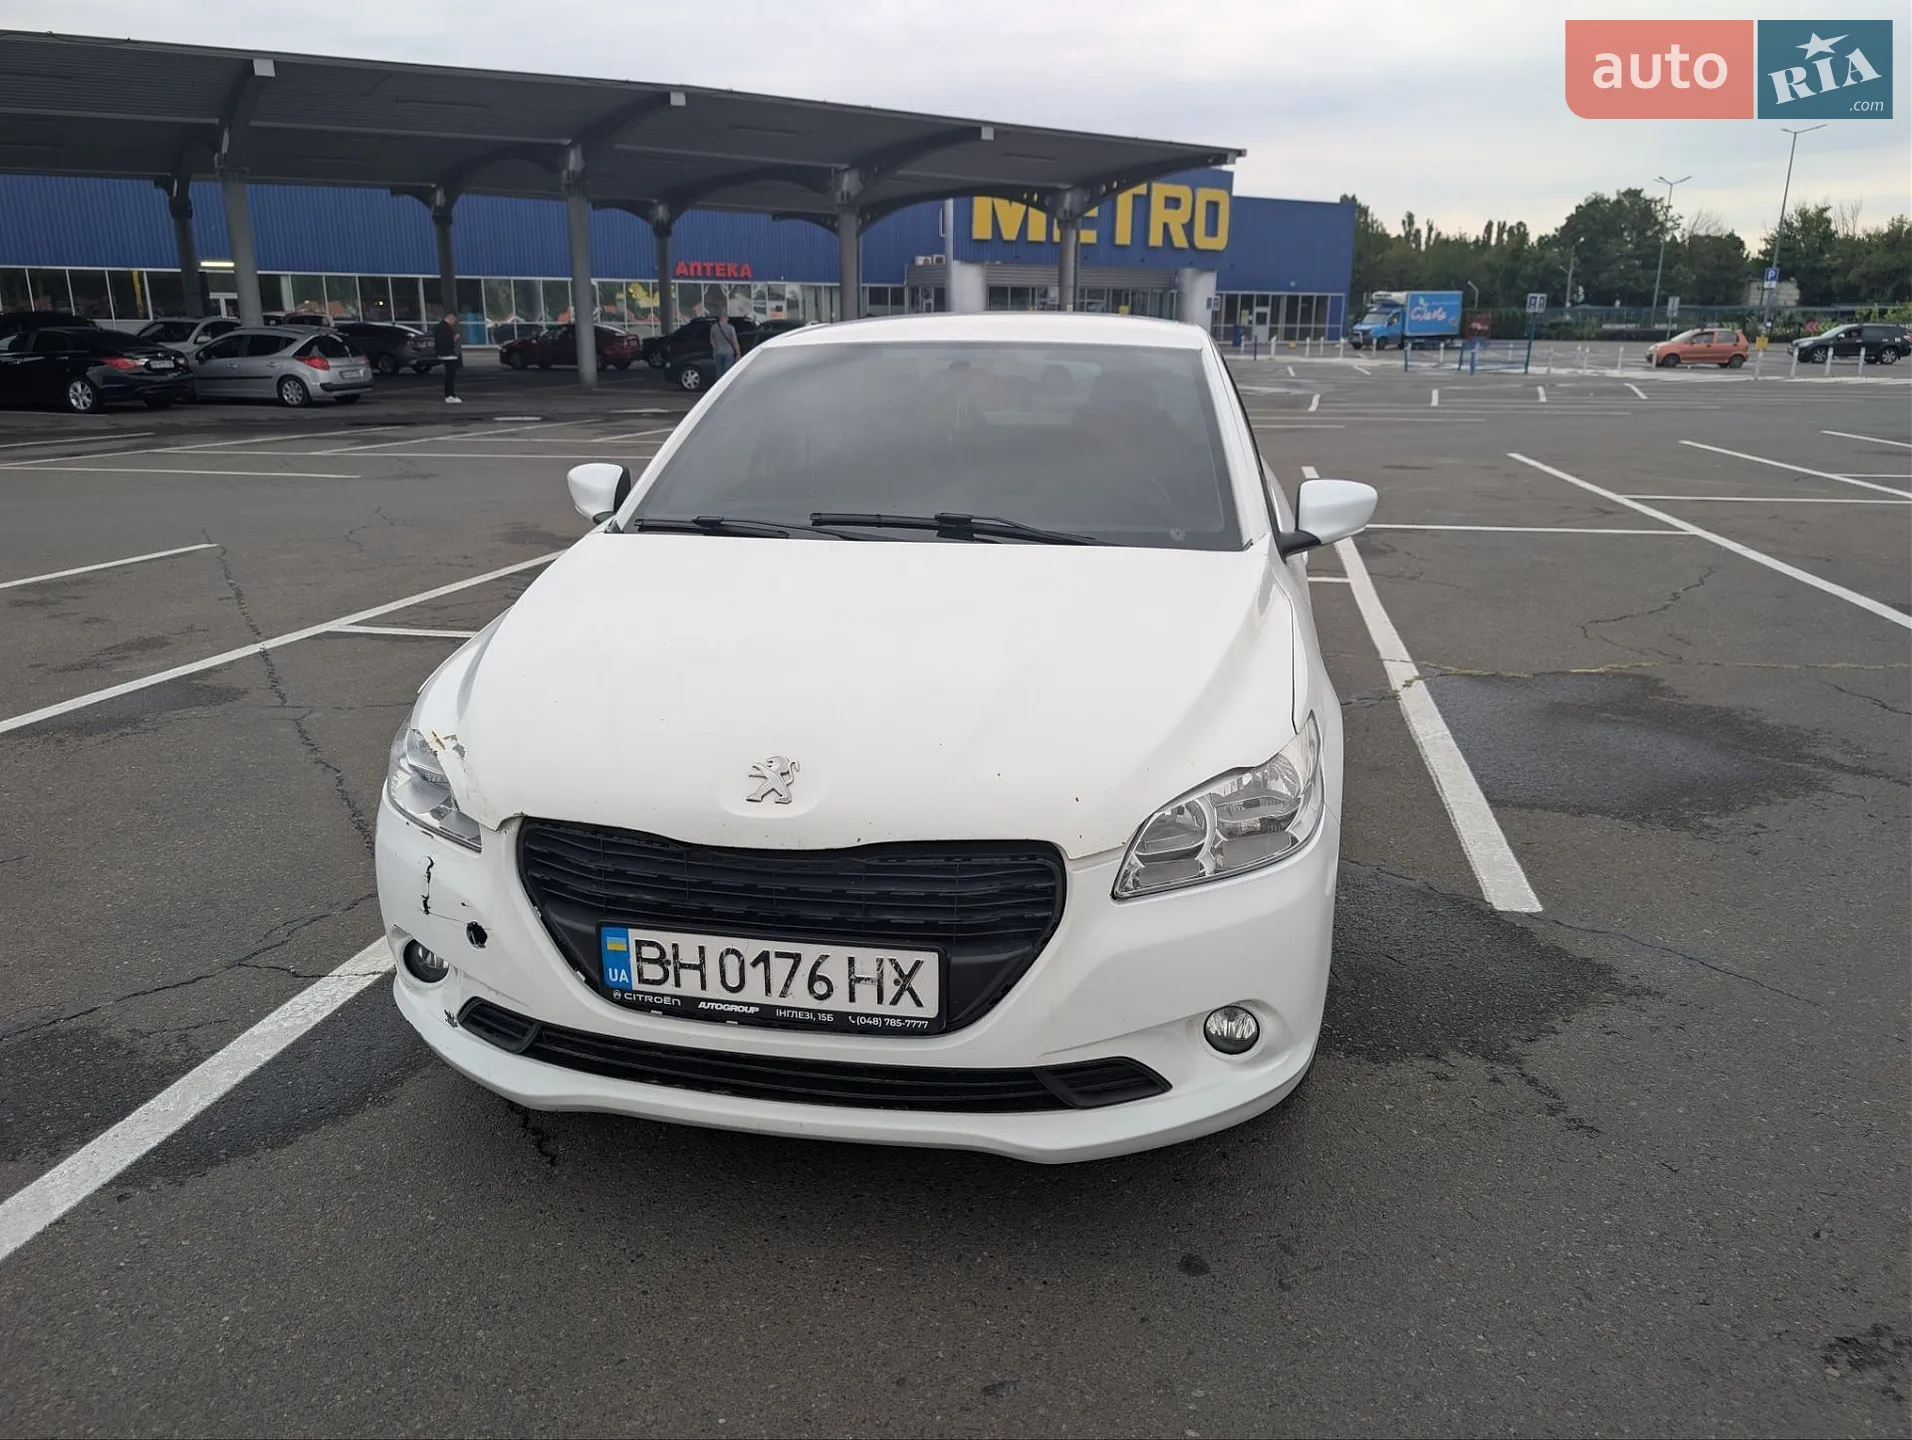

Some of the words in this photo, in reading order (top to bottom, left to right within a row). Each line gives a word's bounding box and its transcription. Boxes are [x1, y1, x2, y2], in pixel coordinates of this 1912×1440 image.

[675, 261, 752, 278] АПТЕКА
[608, 967, 630, 985] UA
[634, 938, 707, 991] BH
[718, 947, 835, 1001] 0176
[847, 956, 925, 1008] HX
[623, 992, 682, 1006] CITROËN
[698, 1001, 760, 1014] AUTOGROUP
[818, 1012, 834, 1022] 15Б
[856, 1015, 882, 1027] (048)
[885, 1018, 929, 1029] 785-7777
